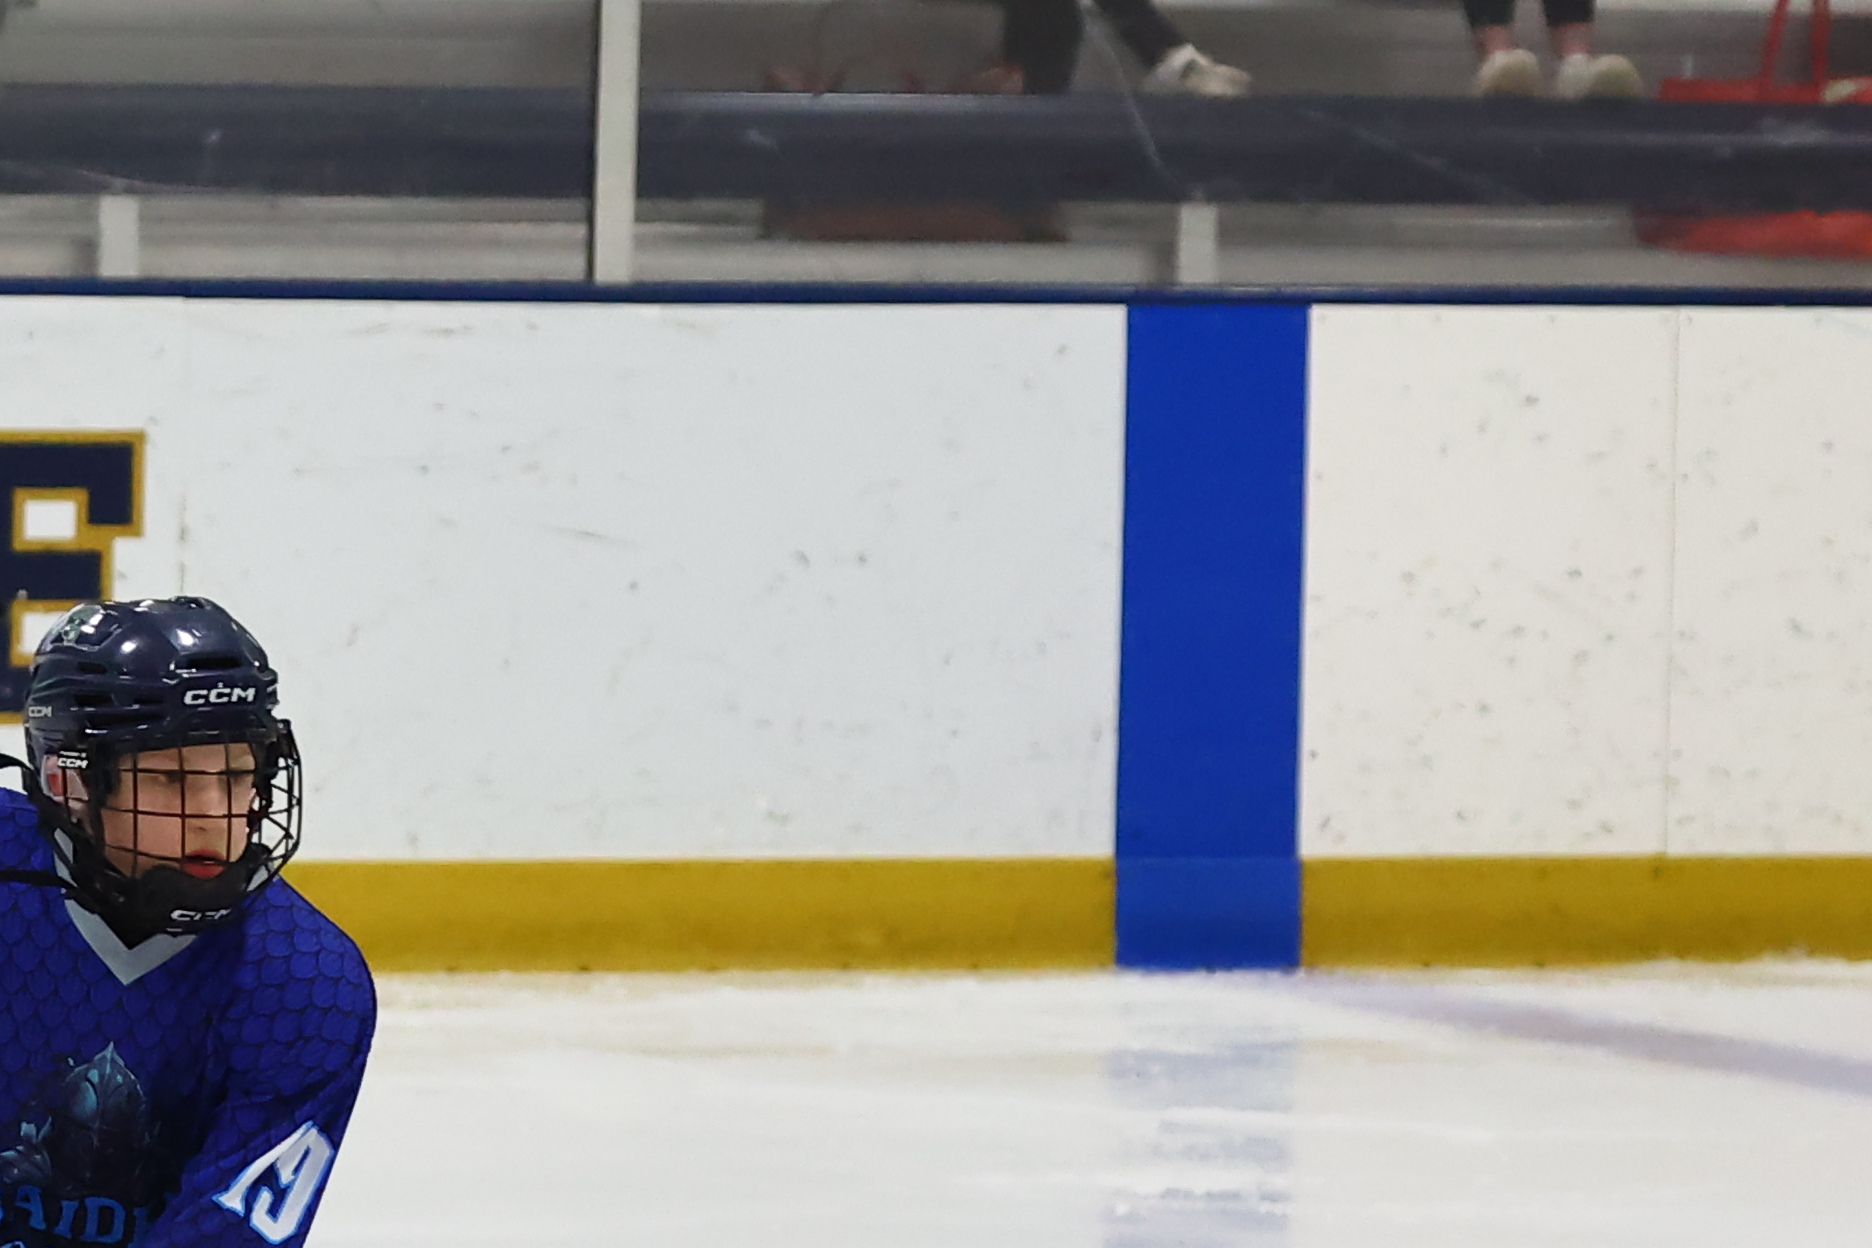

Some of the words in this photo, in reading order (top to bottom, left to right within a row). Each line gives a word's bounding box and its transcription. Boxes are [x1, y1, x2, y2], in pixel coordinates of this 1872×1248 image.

[183, 687, 257, 705] CCM
[28, 706, 53, 718] CCM
[57, 757, 89, 769] CCM
[212, 1119, 335, 1246] 19
